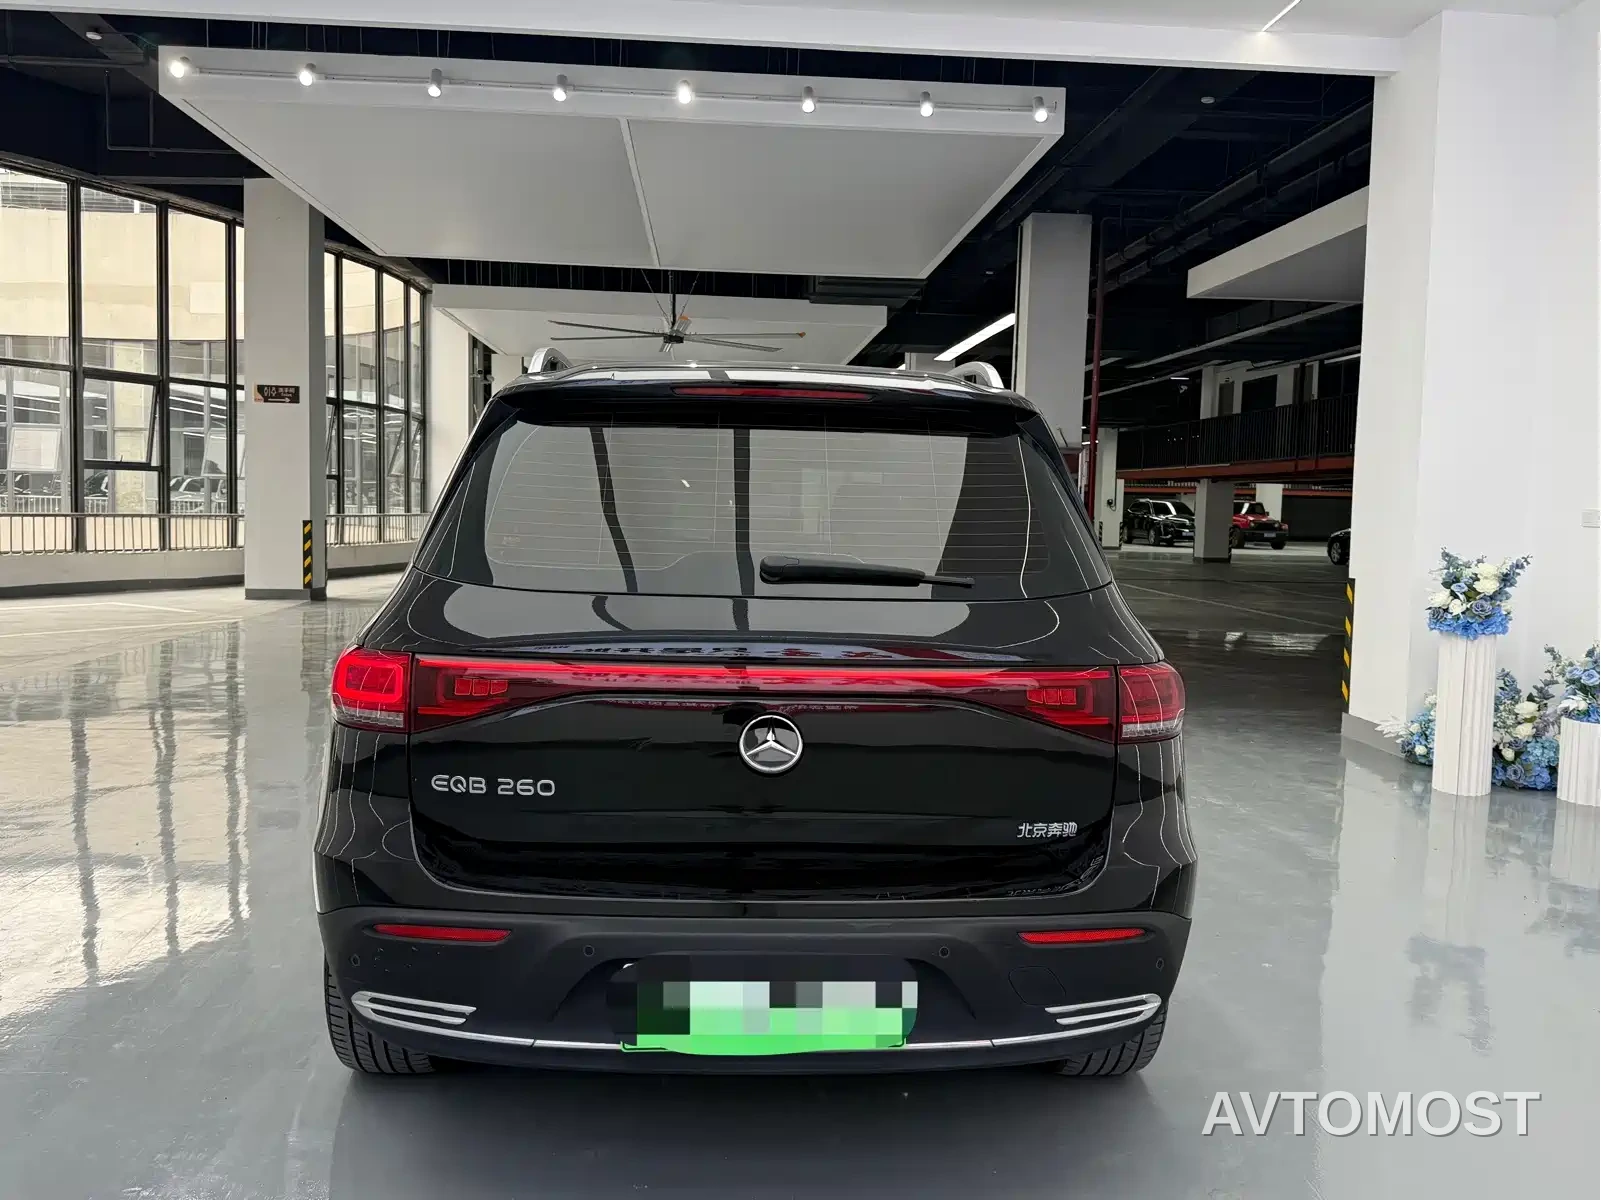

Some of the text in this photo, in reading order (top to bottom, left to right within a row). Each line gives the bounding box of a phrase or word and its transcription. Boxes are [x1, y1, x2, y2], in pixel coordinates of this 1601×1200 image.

[431, 774, 555, 796] EQB 260
[1016, 821, 1078, 838] 北京奔驰
